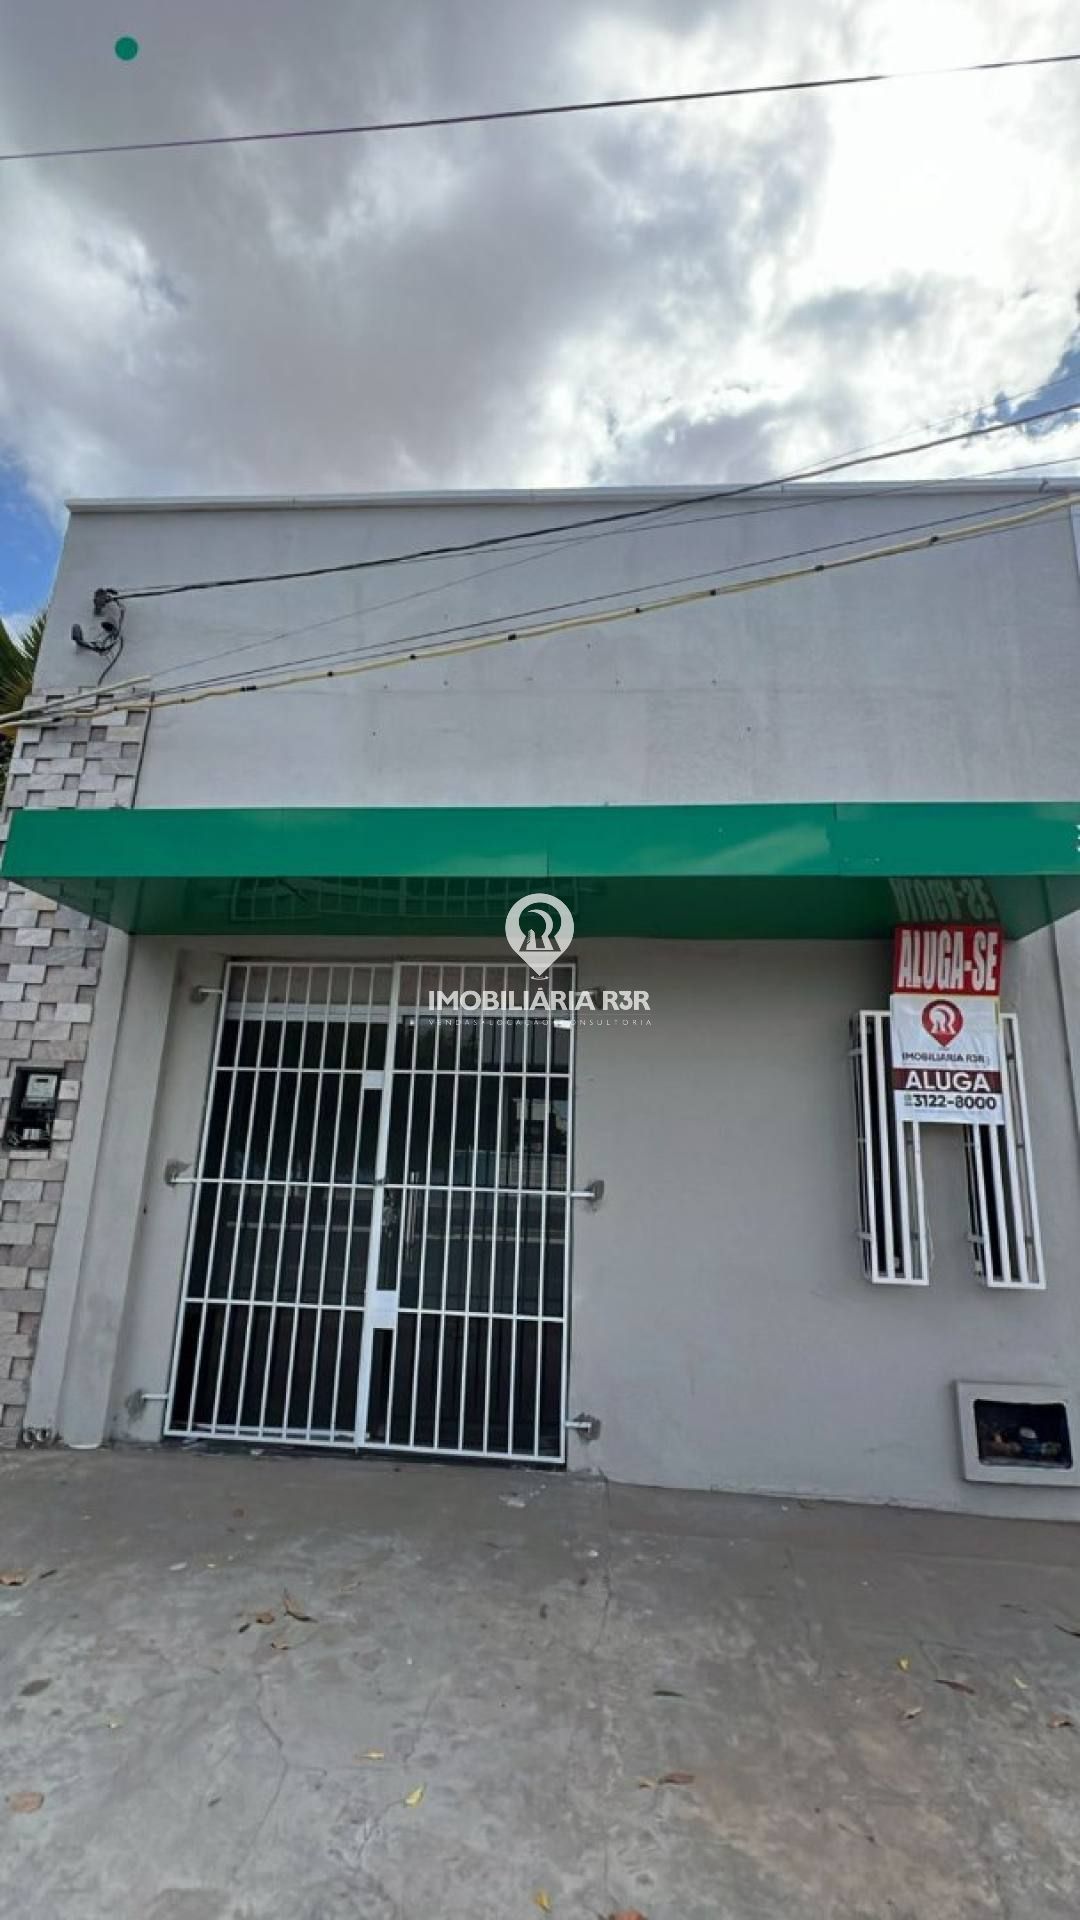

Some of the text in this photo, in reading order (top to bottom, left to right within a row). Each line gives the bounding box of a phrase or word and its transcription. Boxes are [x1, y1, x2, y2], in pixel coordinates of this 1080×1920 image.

[897, 929, 999, 991] ALUGA-SE
[905, 1070, 991, 1092] ALUGA
[913, 1094, 997, 1110] 3122-8000
